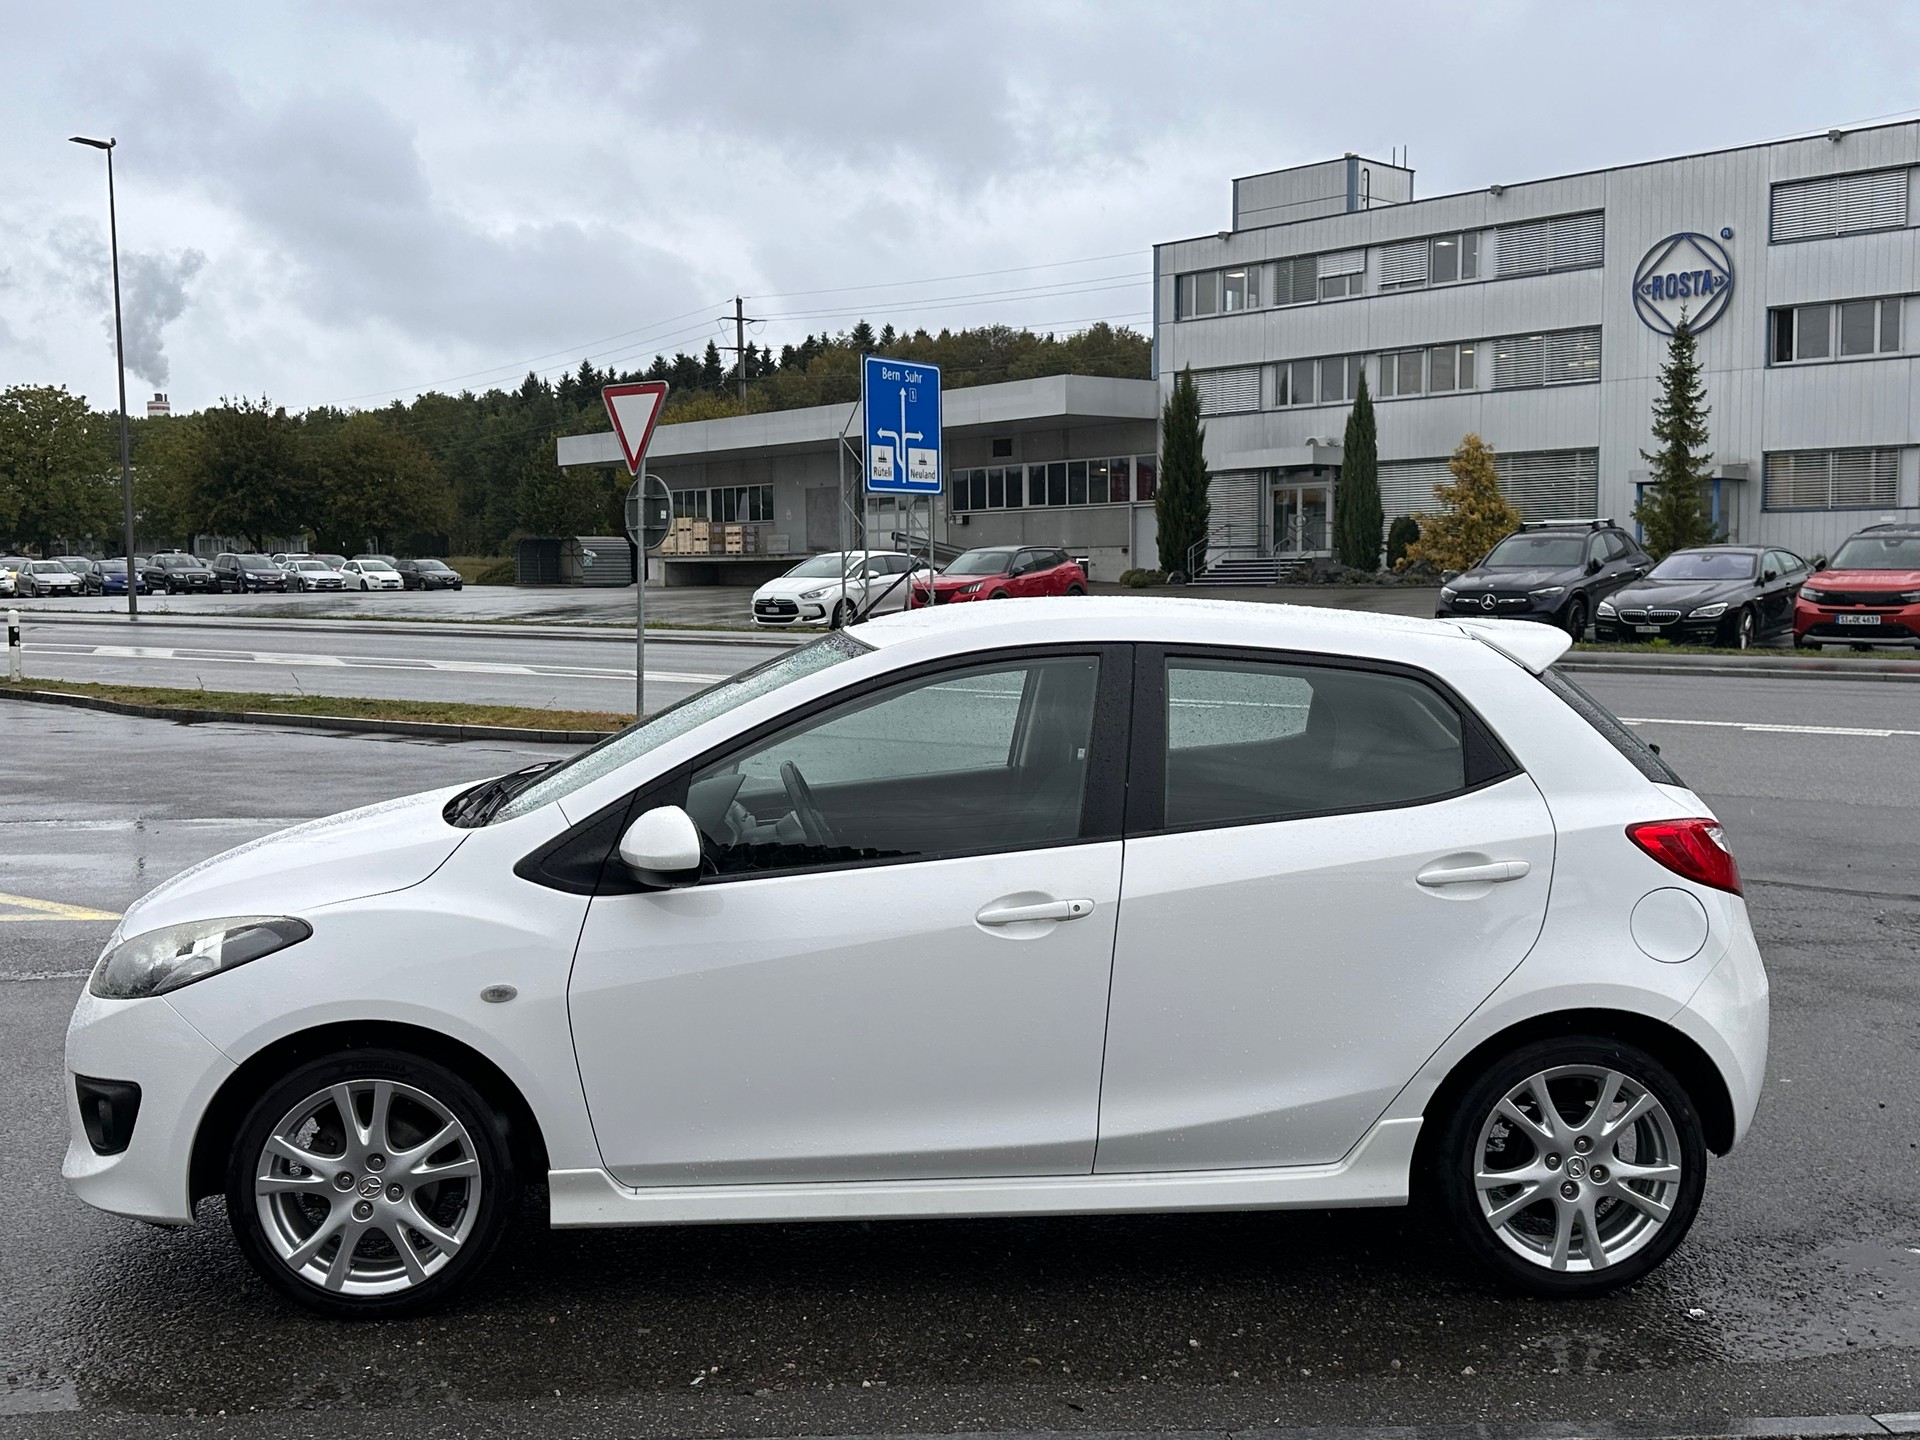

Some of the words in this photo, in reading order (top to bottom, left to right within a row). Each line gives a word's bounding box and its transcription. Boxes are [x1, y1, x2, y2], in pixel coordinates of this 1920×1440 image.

[882, 366, 900, 381] Bern
[904, 369, 922, 384] Suhr
[910, 468, 935, 480] Neuland
